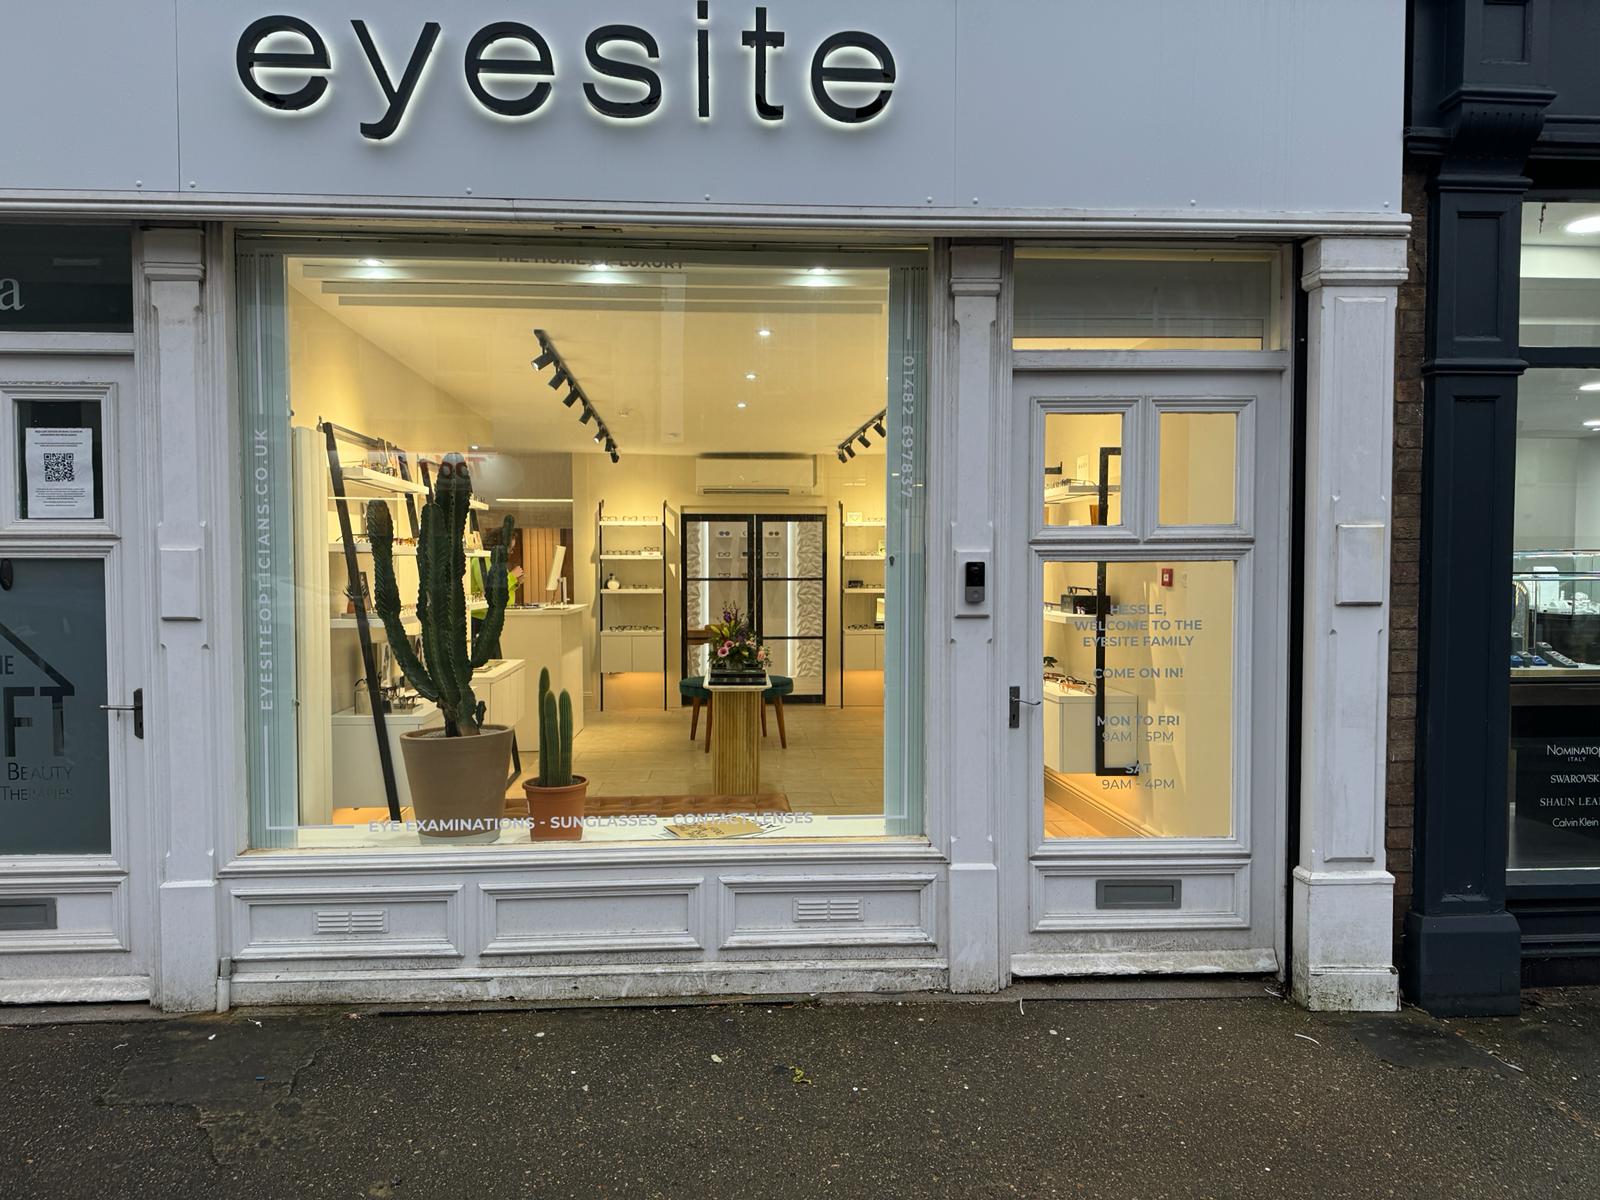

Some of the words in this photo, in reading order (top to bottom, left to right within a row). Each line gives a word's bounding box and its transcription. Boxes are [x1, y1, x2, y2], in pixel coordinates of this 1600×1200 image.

[236, 0, 896, 140] eyesite
[902, 356, 915, 415] 01482
[901, 425, 914, 498] 697837
[254, 429, 274, 711] EYESITEOPTICIANS.CO.UK
[1111, 604, 1167, 617] HESSLE,
[1075, 620, 1149, 632] WELCOME
[1152, 620, 1171, 631] TO
[1176, 619, 1203, 631] THE
[1083, 636, 1139, 648] EYESITE
[1143, 635, 1195, 647] FAMILY
[1093, 668, 1135, 679] COME
[1139, 668, 1160, 679] ON
[1165, 667, 1184, 678] IN!
[1097, 716, 1131, 727] MON
[1136, 716, 1154, 727] TO
[1158, 715, 1180, 726] FRI
[1102, 732, 1132, 743] 9AM
[1145, 731, 1174, 742] 5PM
[1546, 744, 1600, 757] NOMINATIO
[1125, 763, 1152, 774] SAT
[1102, 779, 1132, 790] 9AM
[1145, 779, 1175, 790] 4PM
[1540, 797, 1575, 807] SHAUN
[369, 820, 400, 832] EYE
[406, 816, 535, 832] EXAMINATIONS
[550, 814, 658, 829] SUNGLASSES
[673, 812, 750, 826] CONTACT
[755, 811, 813, 825] LENSES
[1552, 817, 1578, 827] Calvin
[1580, 816, 1599, 827] Klein
